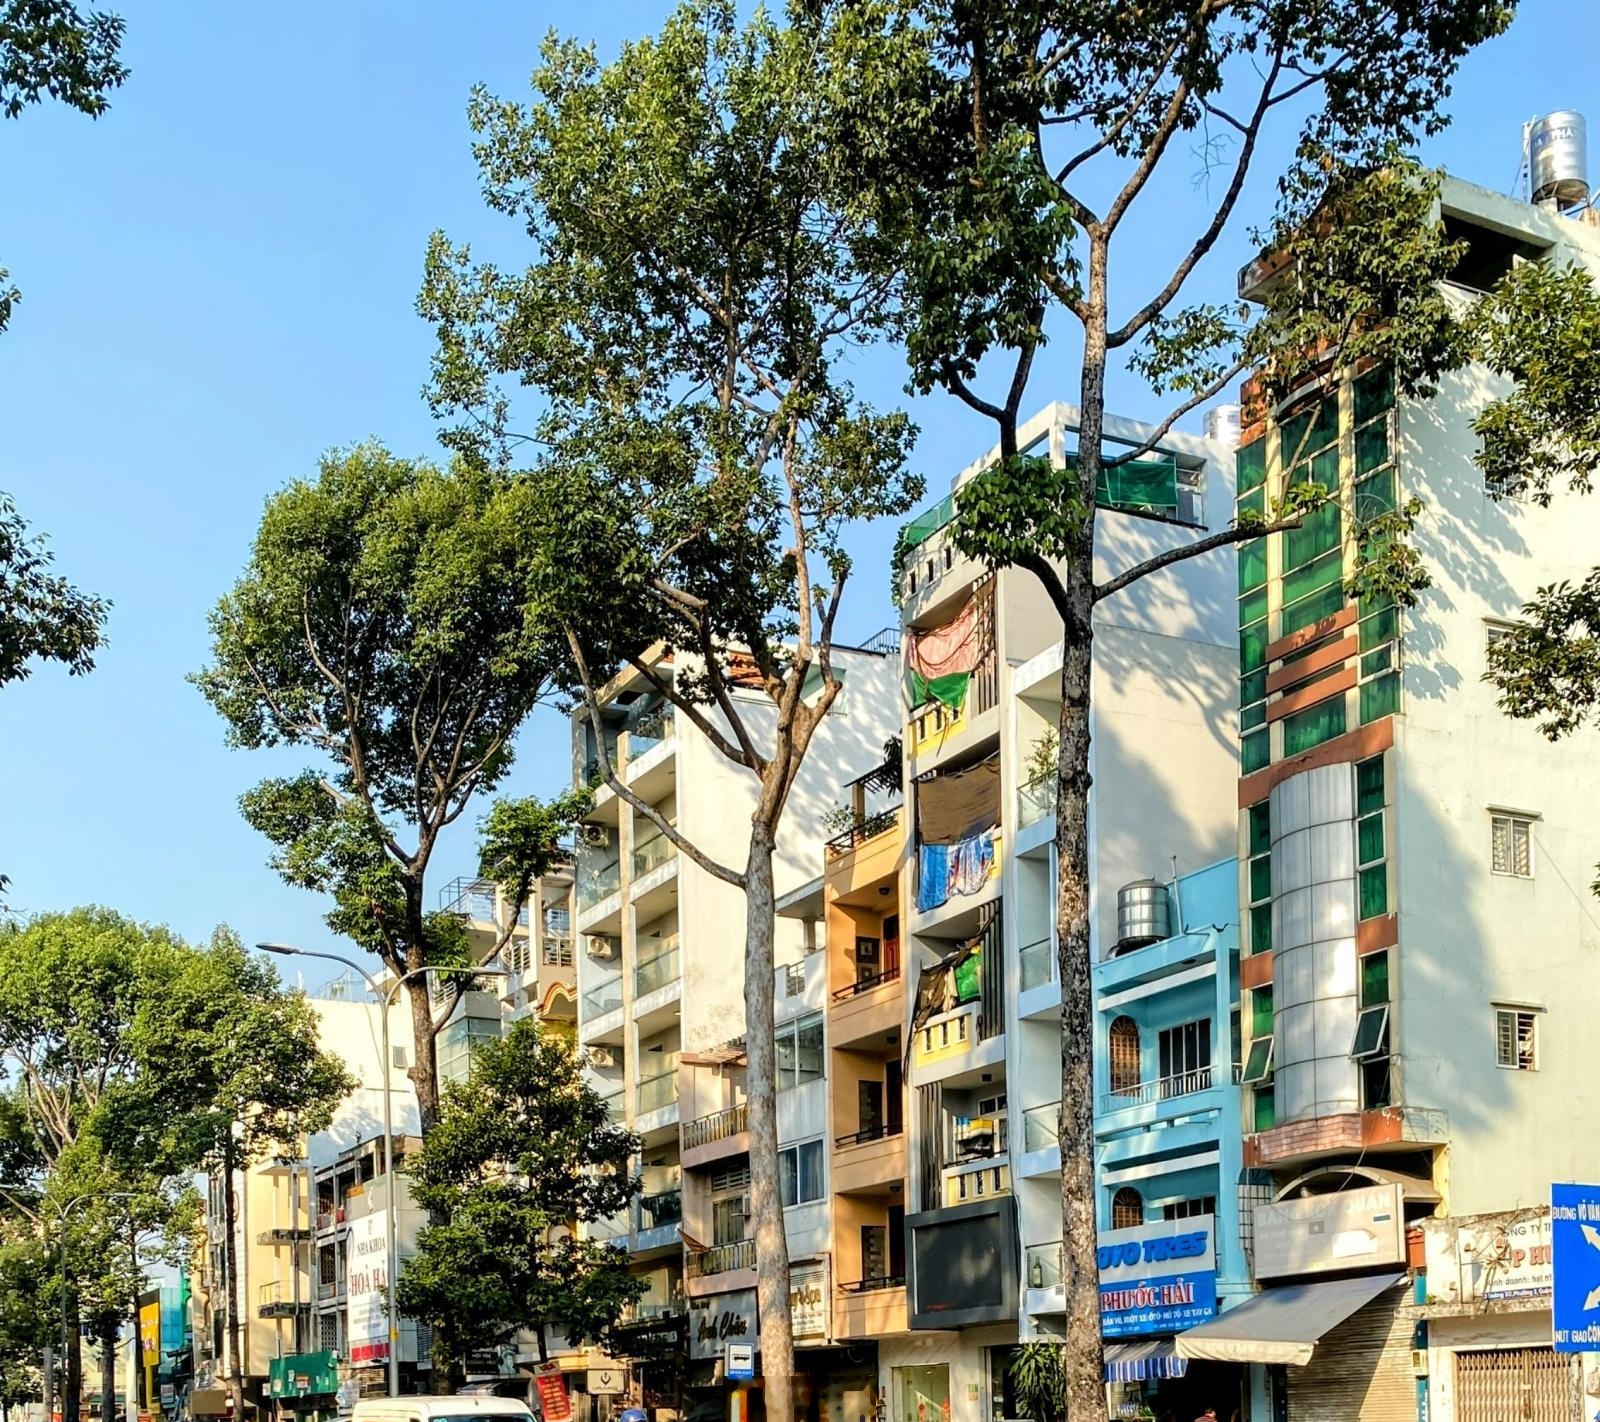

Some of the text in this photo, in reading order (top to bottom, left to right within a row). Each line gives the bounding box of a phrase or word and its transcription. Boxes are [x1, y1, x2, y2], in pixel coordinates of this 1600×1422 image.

[1552, 1204, 1577, 1220] ĐƯỜNG
[1142, 1231, 1209, 1264] TIRES
[1101, 1277, 1195, 1313] PHƯỚC HẢI
[1555, 1327, 1570, 1343] NÚT
[1571, 1329, 1587, 1343] GIAO
